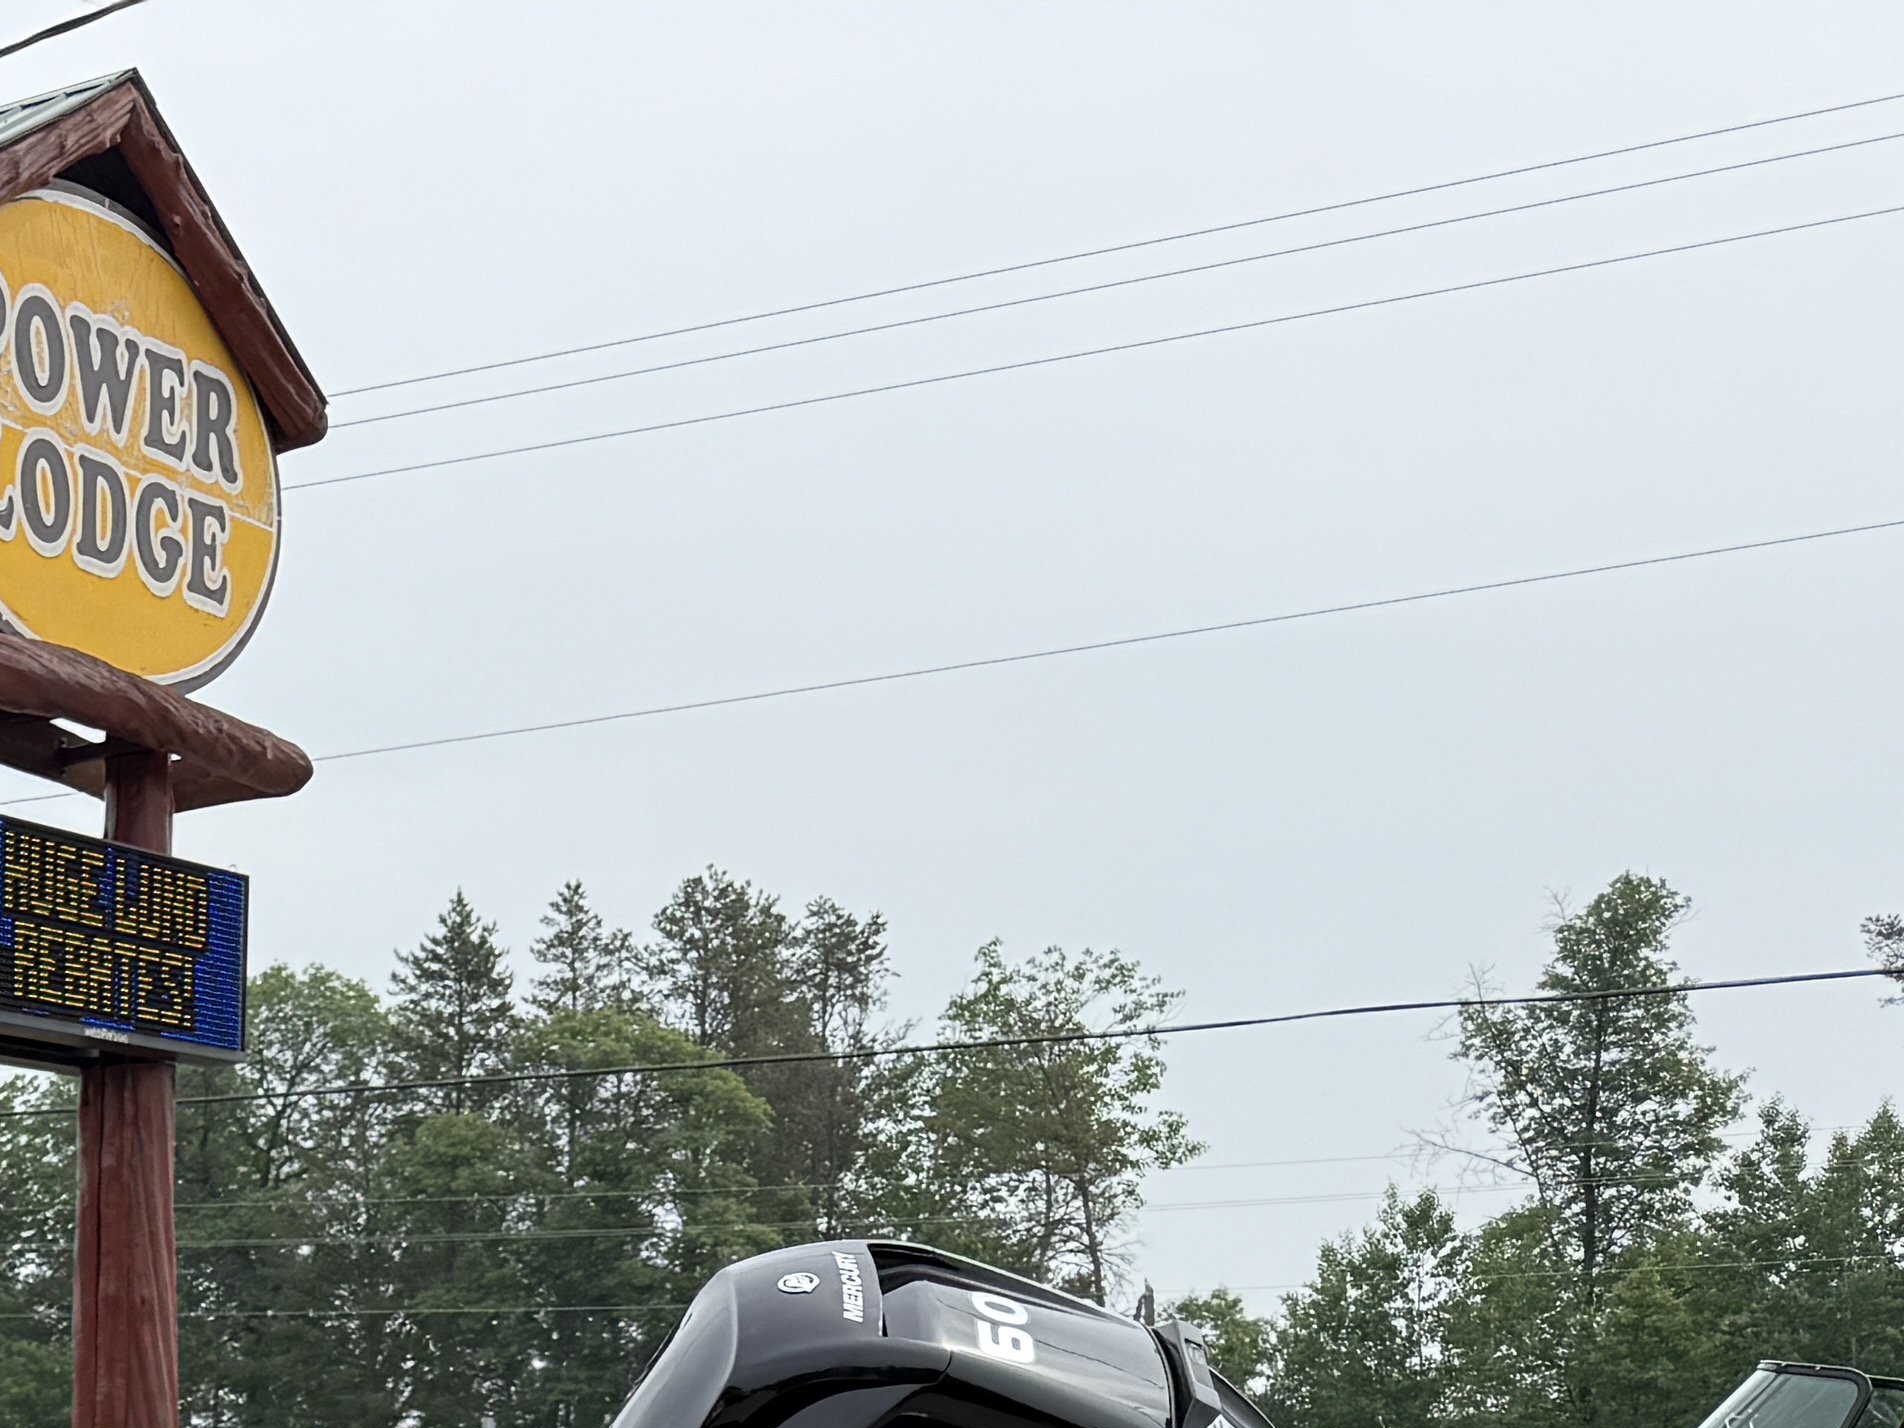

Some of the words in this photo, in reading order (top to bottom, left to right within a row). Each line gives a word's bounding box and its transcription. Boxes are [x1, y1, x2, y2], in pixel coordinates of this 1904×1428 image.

[4, 830, 104, 928] HUGE
[114, 858, 208, 950] LUND
[832, 1250, 864, 1323] MERCURY
[970, 1291, 1036, 1365] 60
